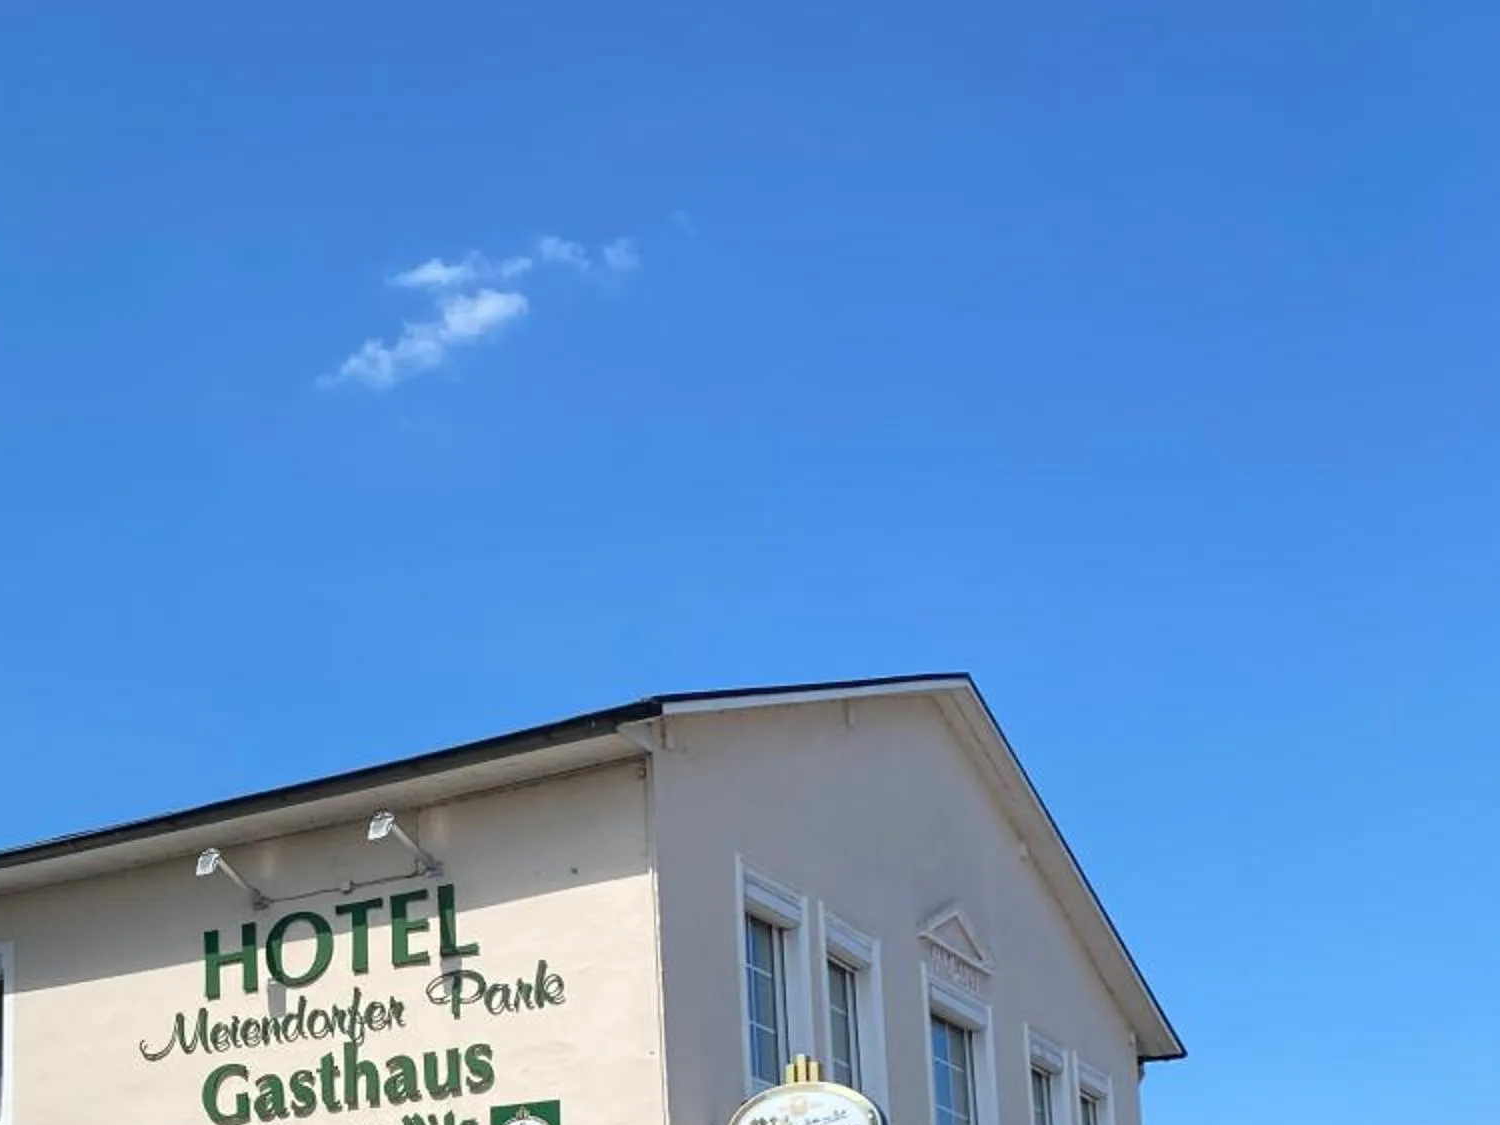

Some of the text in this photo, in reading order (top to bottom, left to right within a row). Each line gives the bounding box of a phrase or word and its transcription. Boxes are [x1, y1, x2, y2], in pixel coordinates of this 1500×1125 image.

[204, 883, 478, 1000] HOTEL
[140, 960, 566, 1061] Meiendorfer Park
